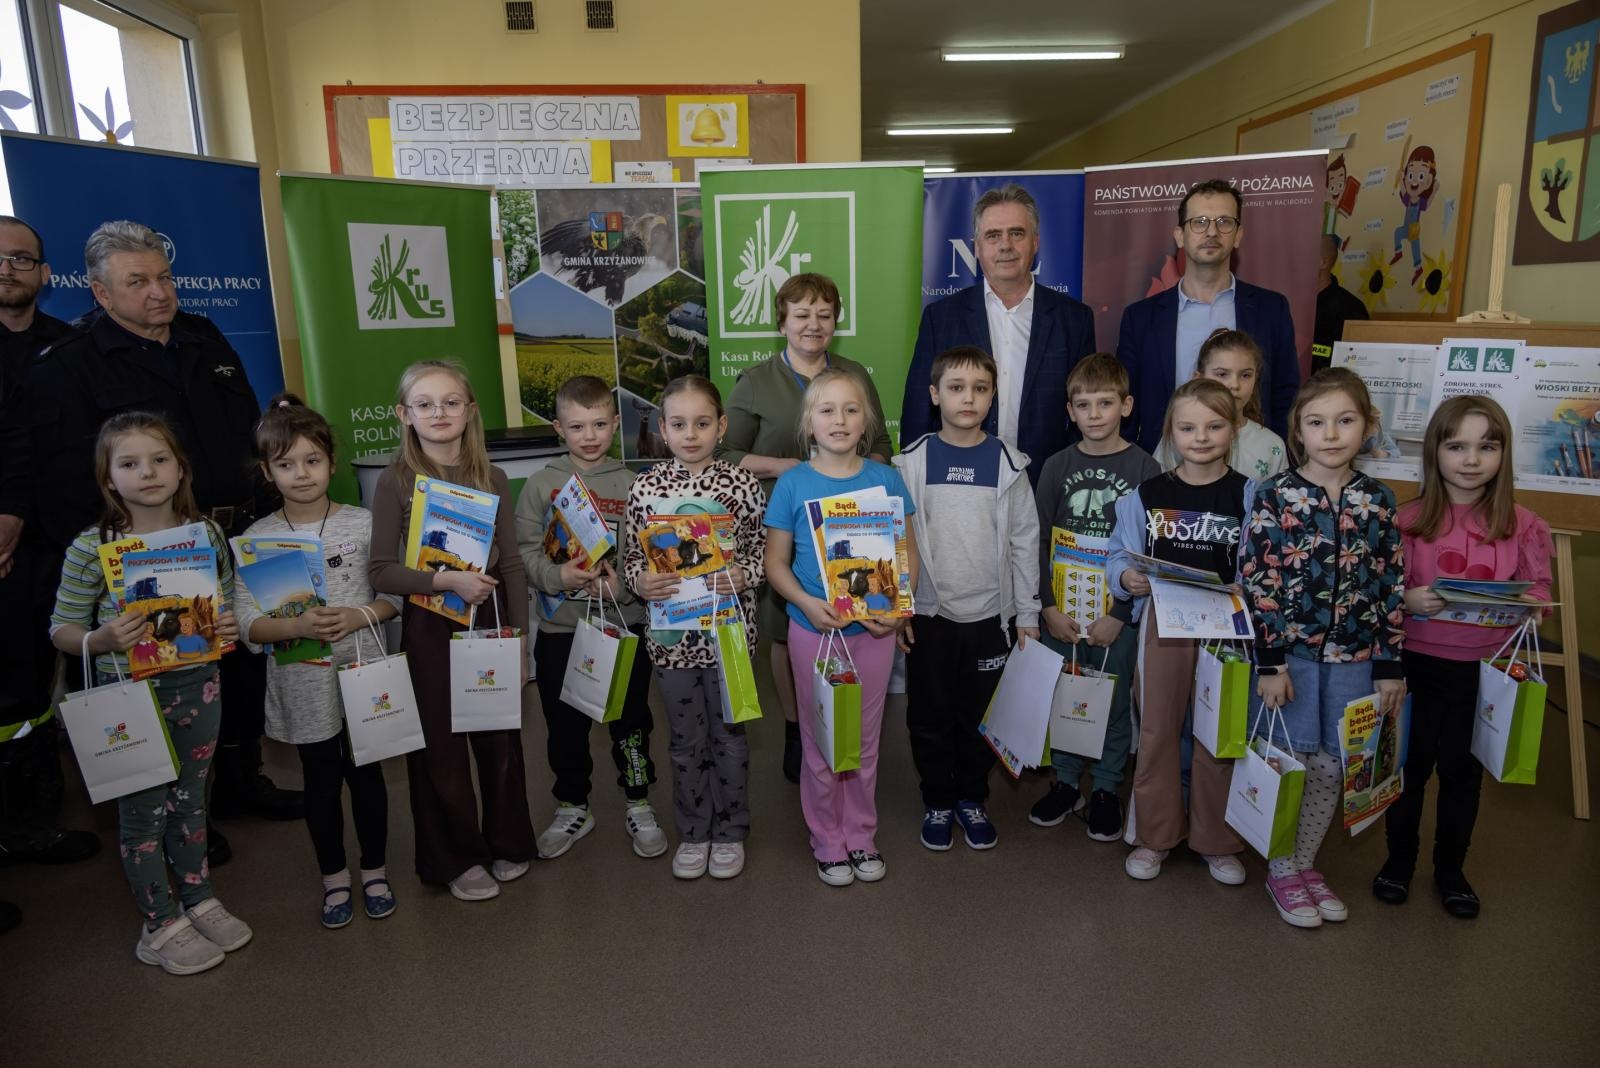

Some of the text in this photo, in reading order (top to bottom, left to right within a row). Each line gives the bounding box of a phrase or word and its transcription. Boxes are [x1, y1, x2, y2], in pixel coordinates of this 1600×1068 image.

[396, 103, 640, 131] BEZPIECZNA
[399, 148, 589, 175] PRZERWA
[1095, 184, 1187, 201] PAŃSTWOWA
[1241, 175, 1313, 192] POŻARNA
[1094, 208, 1123, 216] KOMENDA
[1125, 206, 1162, 214] POWIATOWA
[564, 254, 657, 266] GMINA KRZYŻANOWICE
[224, 277, 261, 290] PRACY
[212, 298, 239, 307] PRACY
[721, 351, 749, 362] Kasa
[1392, 381, 1422, 389] TROSKI
[1535, 384, 1569, 392] WIOSKI
[1572, 385, 1590, 393] BEZ
[351, 405, 397, 422] KASA
[714, 492, 743, 520] GIRL
[835, 502, 857, 511] Bądź
[1146, 509, 1241, 545] Positive
[115, 540, 145, 554] Bądź
[1173, 541, 1213, 551] VIBES ONLY
[127, 558, 173, 567] PRZYGODA
[112, 568, 122, 576] w
[1355, 703, 1374, 716] Bądź
